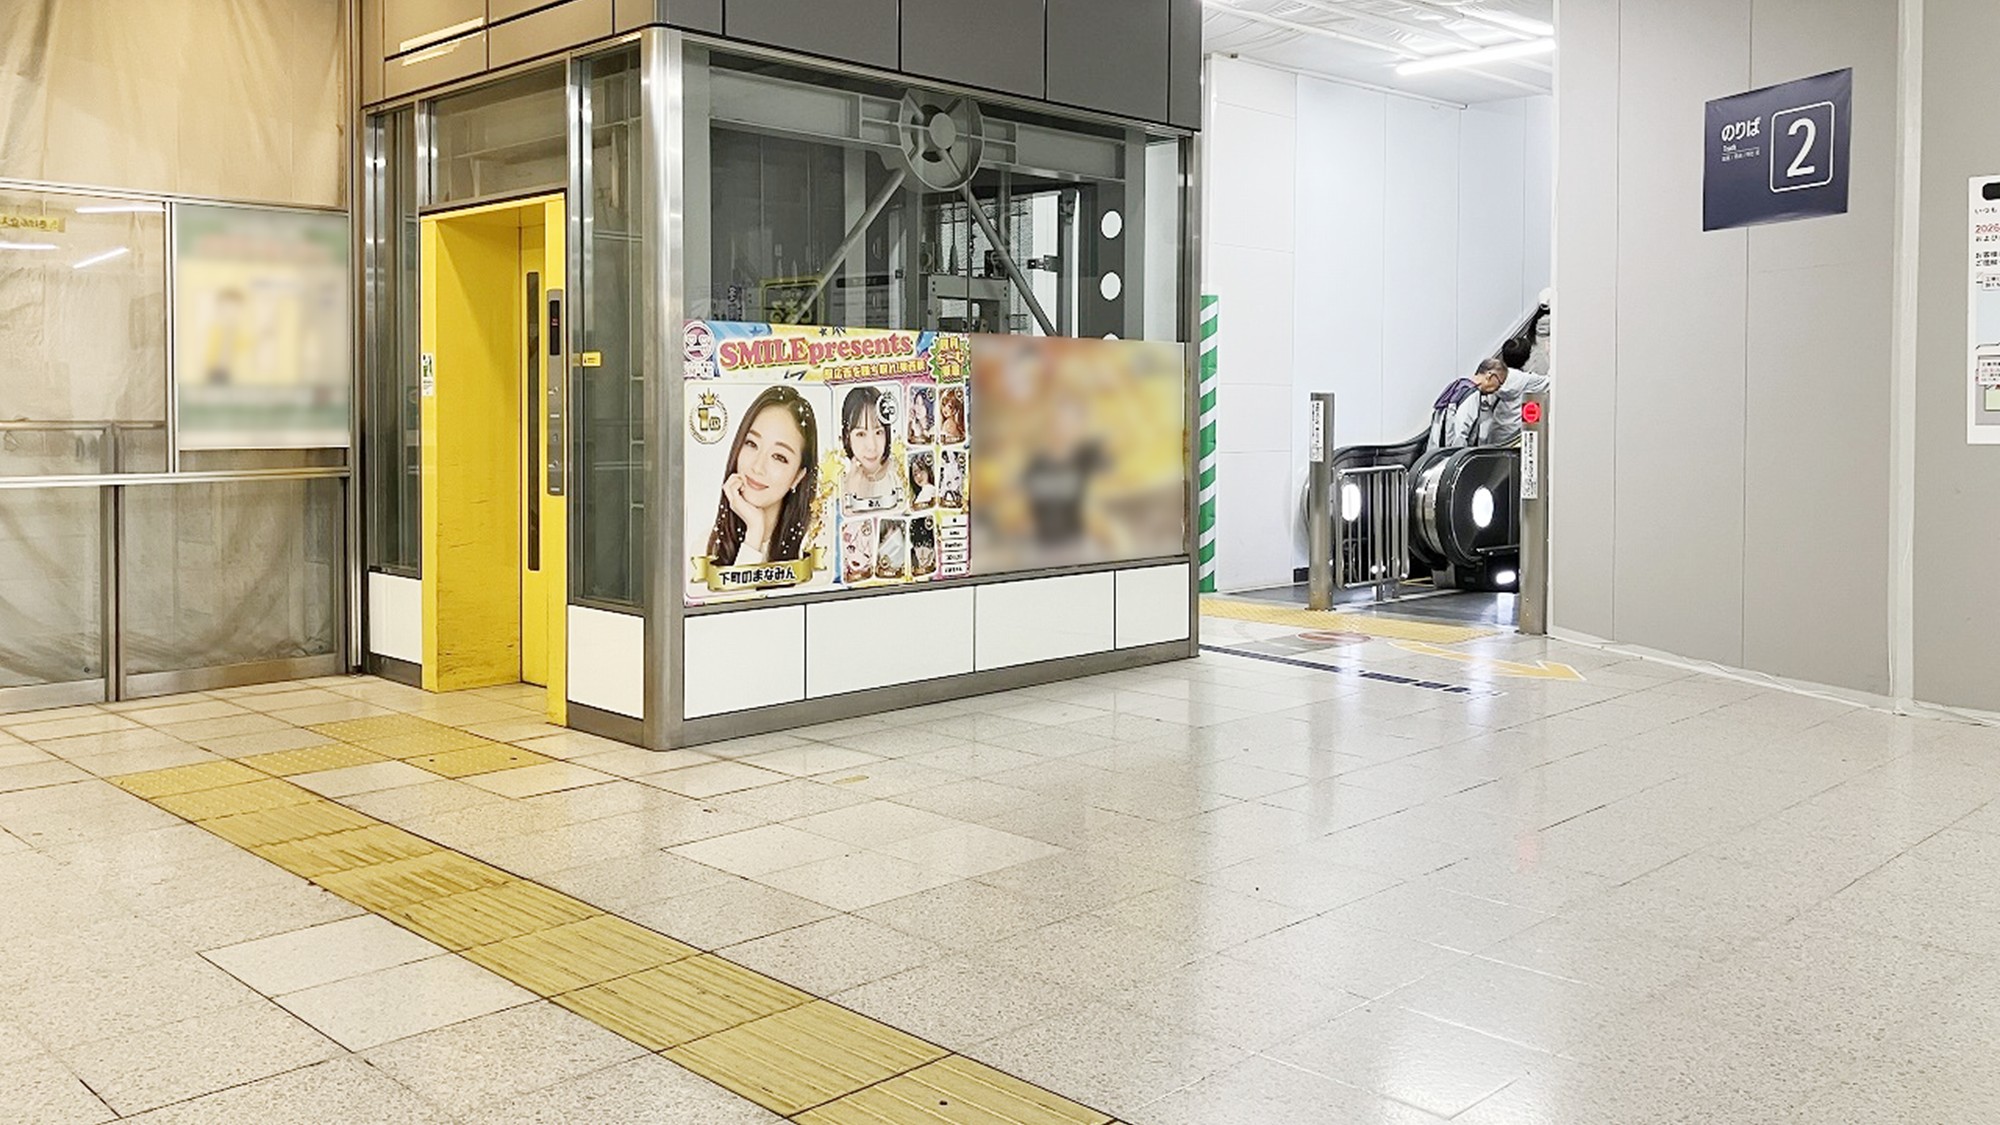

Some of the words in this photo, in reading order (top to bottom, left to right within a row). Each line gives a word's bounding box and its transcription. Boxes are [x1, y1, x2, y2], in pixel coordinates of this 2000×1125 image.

[1721, 116, 1761, 142] のりば
[1786, 117, 1817, 178] 2
[1975, 235, 2000, 243] および
[1975, 251, 2000, 259] お客様
[719, 566, 796, 585] 下町のまなみん
